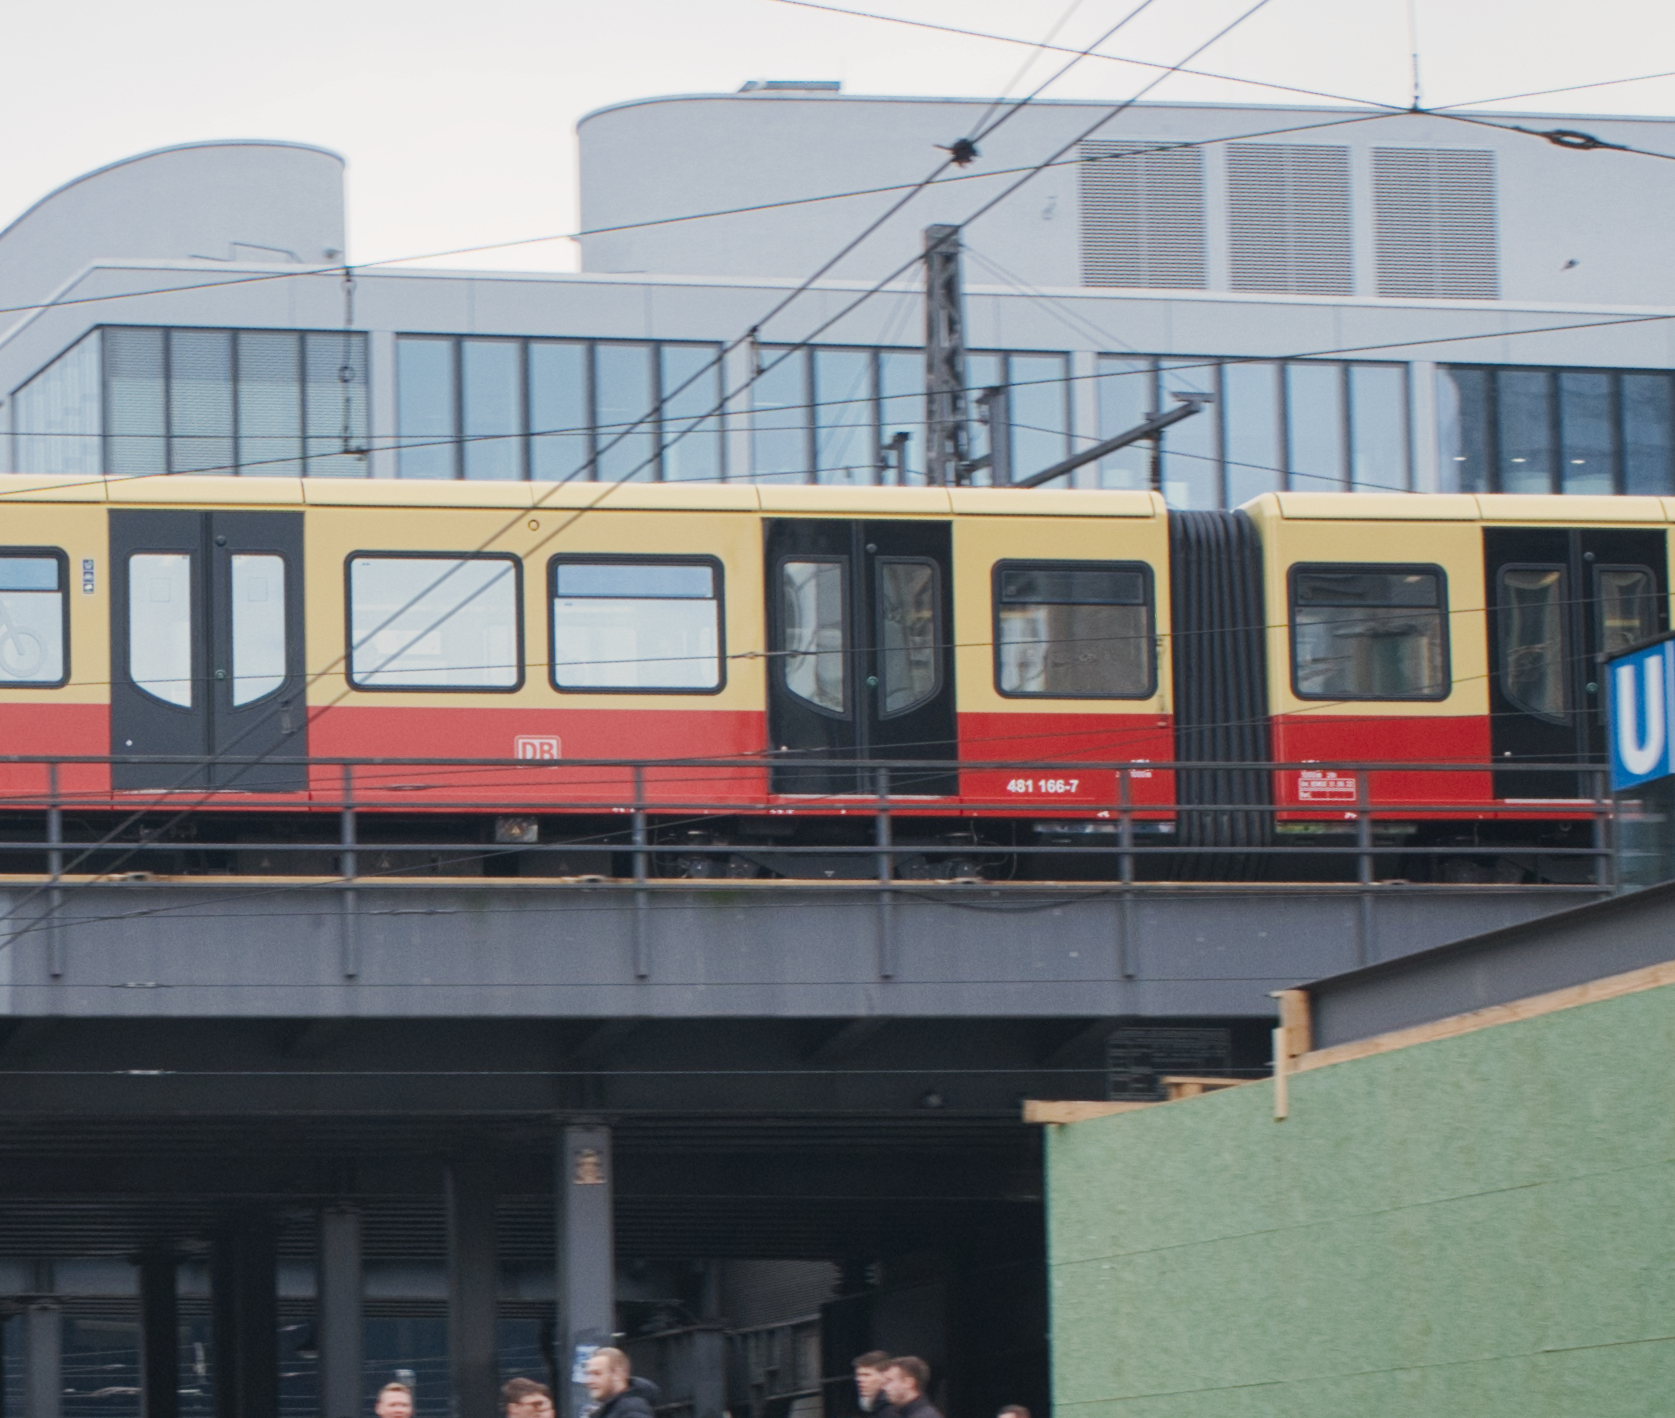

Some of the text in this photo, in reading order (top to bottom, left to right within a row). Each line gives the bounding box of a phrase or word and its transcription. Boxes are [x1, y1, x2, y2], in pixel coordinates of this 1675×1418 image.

[1615, 654, 1665, 775] U
[521, 741, 555, 760] DB
[1007, 779, 1080, 793] 481 166-7
